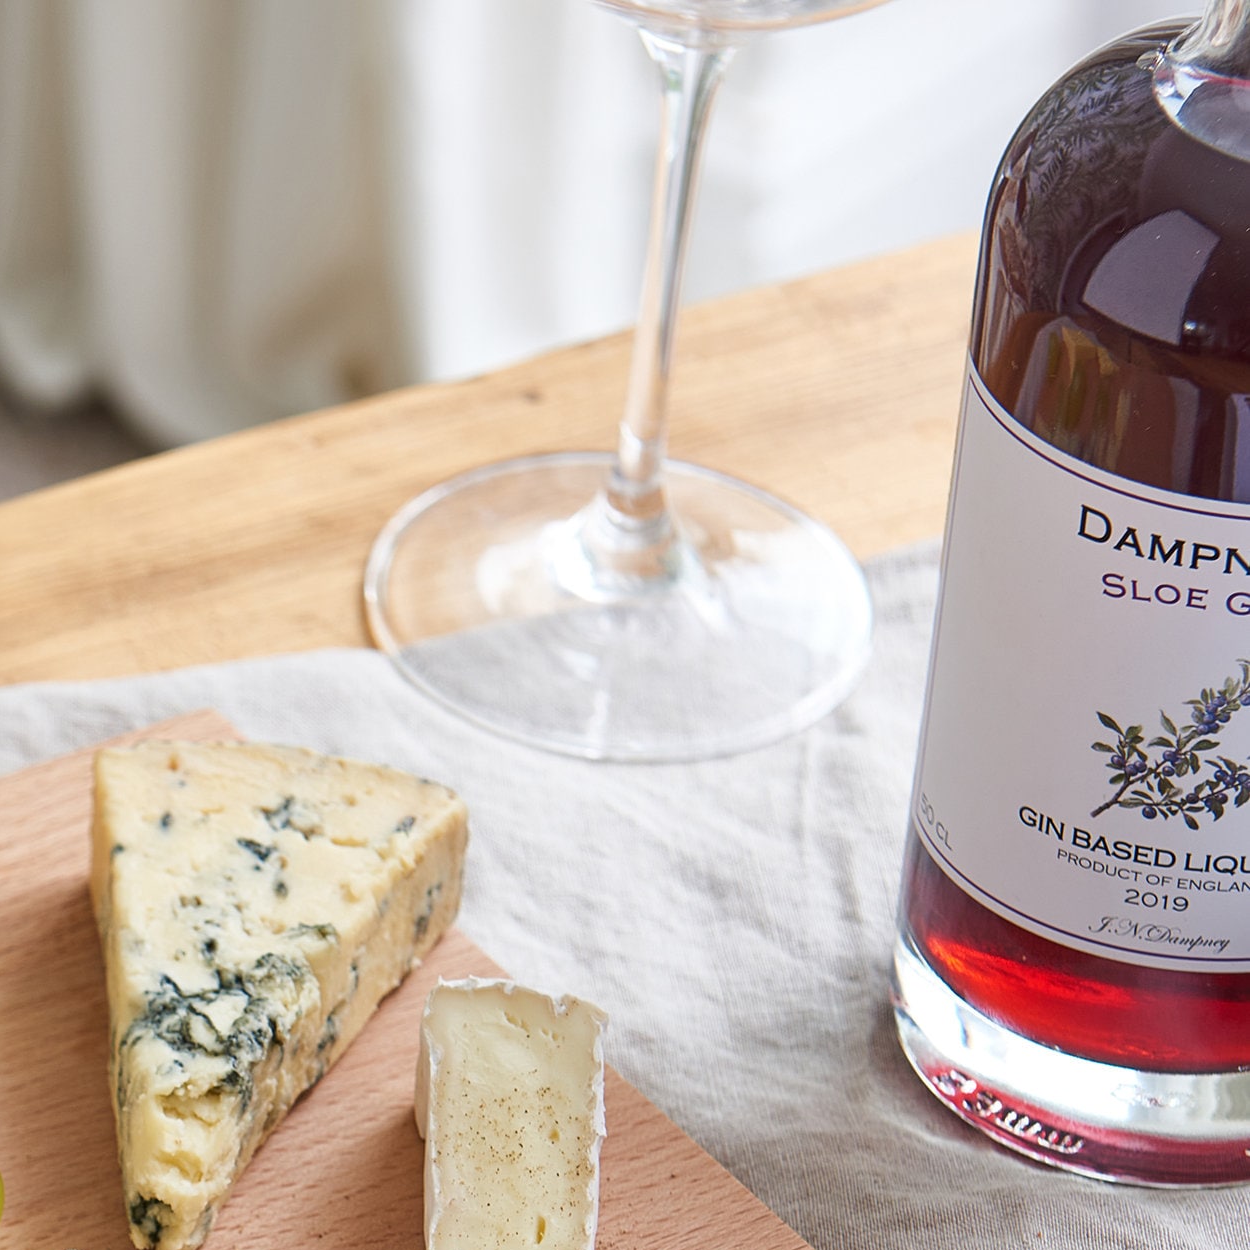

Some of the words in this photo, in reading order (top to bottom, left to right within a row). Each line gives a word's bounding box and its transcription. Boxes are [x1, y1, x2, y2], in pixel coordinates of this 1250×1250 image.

[1102, 573, 1210, 611] SLOE
[1018, 805, 1065, 841] GIN
[1071, 827, 1177, 869] BASED
[1056, 848, 1143, 883] PRODUCT
[1145, 873, 1173, 887] OF
[1124, 888, 1190, 912] 2019
